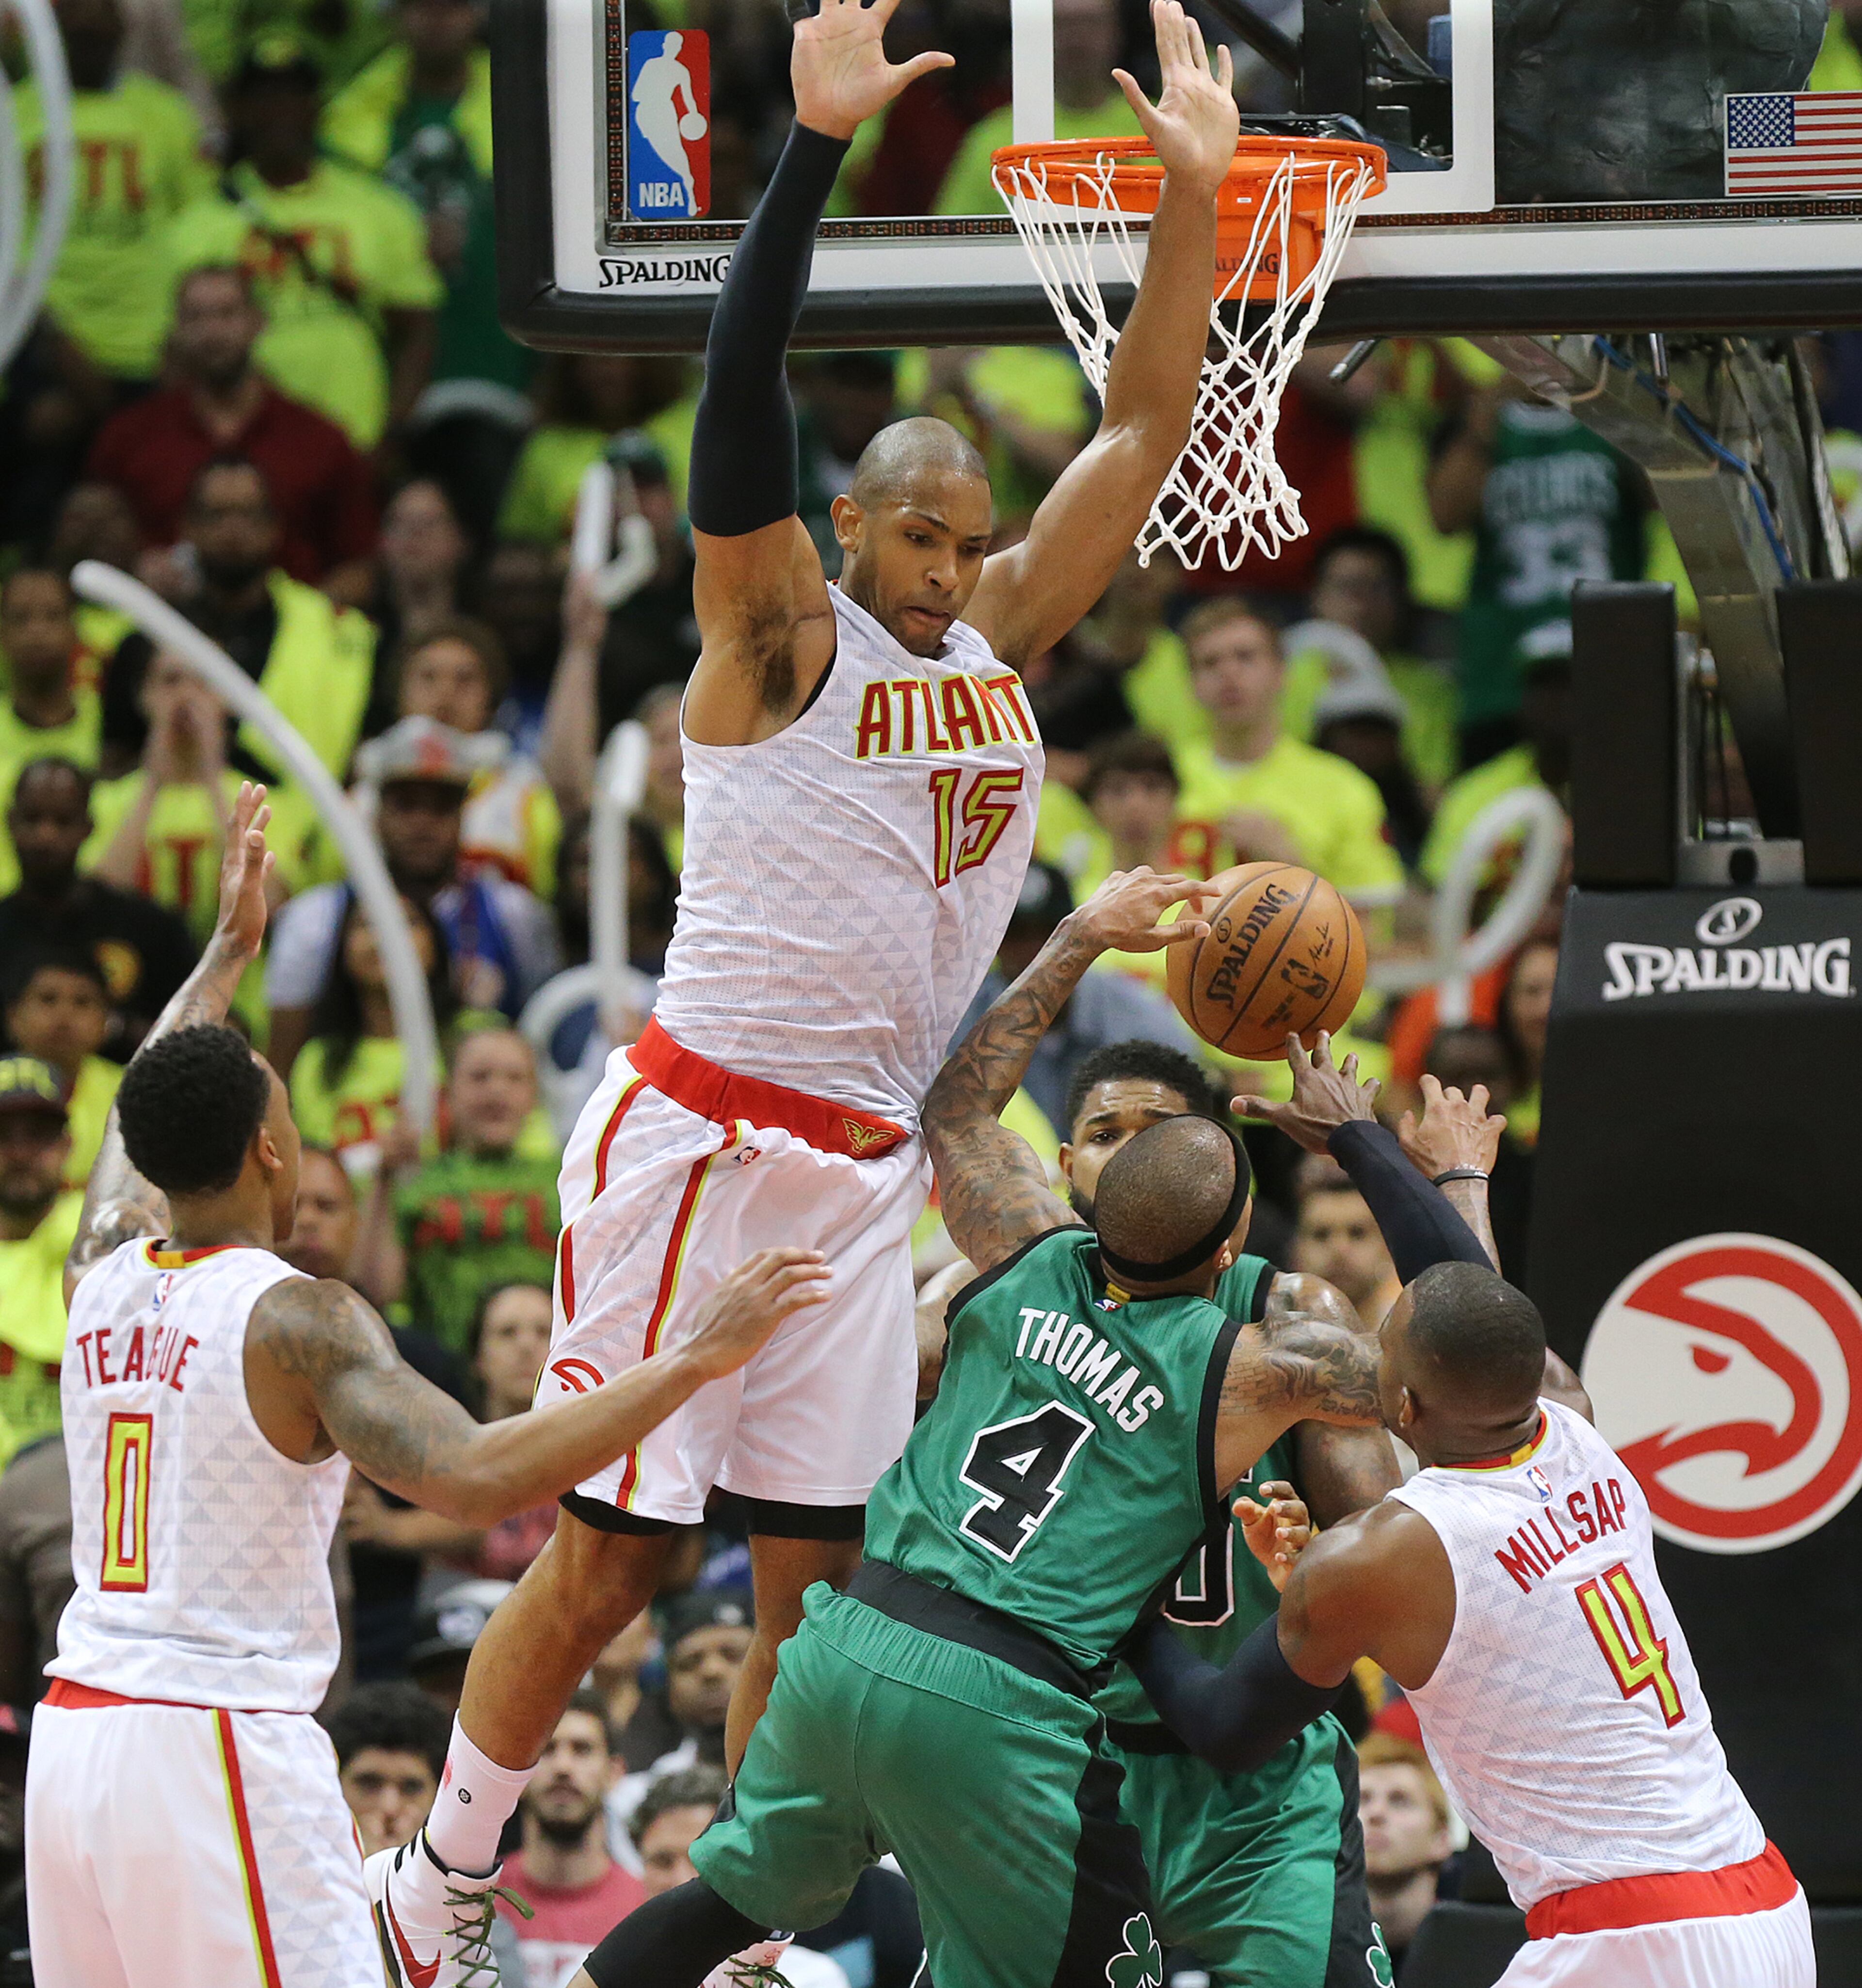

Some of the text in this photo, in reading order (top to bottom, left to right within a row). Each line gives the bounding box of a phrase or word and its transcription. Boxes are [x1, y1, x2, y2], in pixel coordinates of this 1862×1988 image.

[639, 182, 685, 207] NBA
[599, 255, 732, 288] SPALDING
[928, 767, 1024, 889] 15
[1206, 883, 1300, 1011] SPALDING
[1602, 937, 1851, 1002] SPALDING
[76, 1326, 199, 1393] TEAGUE
[1015, 1307, 1165, 1432] THOMAS
[99, 1412, 153, 1593] 0
[959, 1399, 1097, 1564] 4
[1494, 1478, 1627, 1595] MILLSAP
[1574, 1561, 1687, 1730] 4
